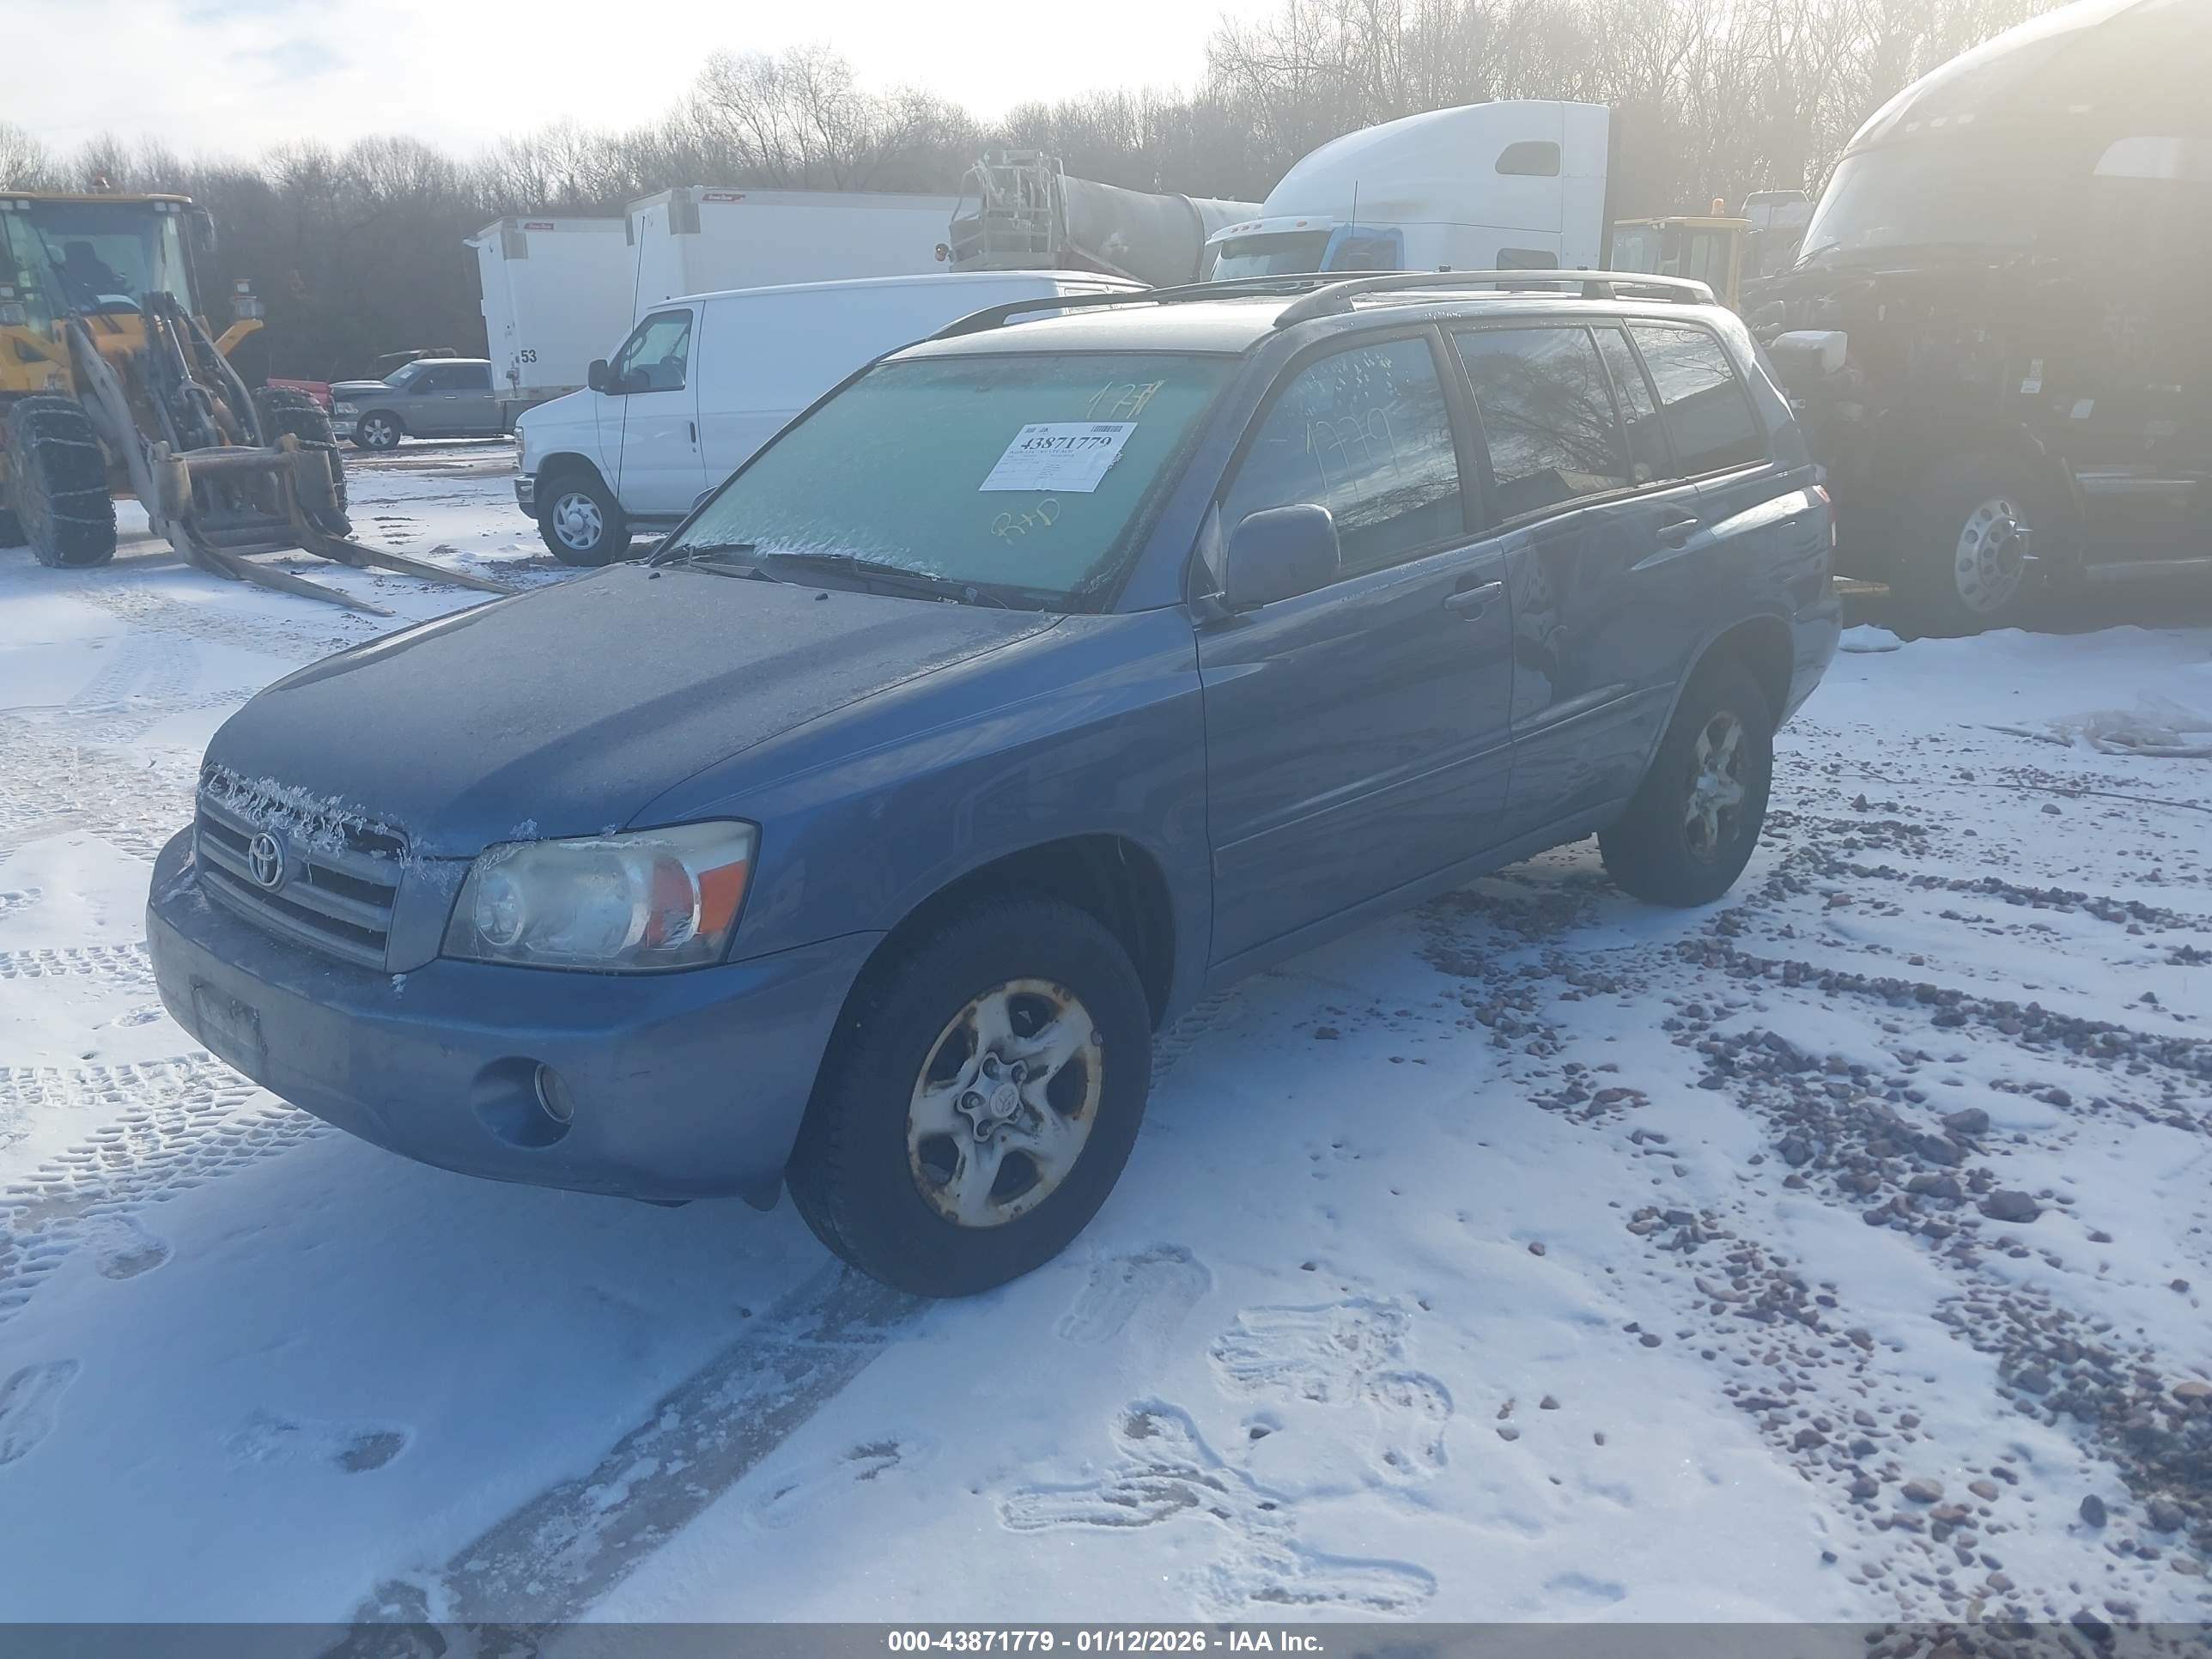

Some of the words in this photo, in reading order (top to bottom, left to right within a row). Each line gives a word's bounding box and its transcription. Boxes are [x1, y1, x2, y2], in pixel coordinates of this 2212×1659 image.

[520, 349, 538, 363] 53
[1020, 436, 1113, 450] 43871779
[1306, 408, 1401, 502] 1779
